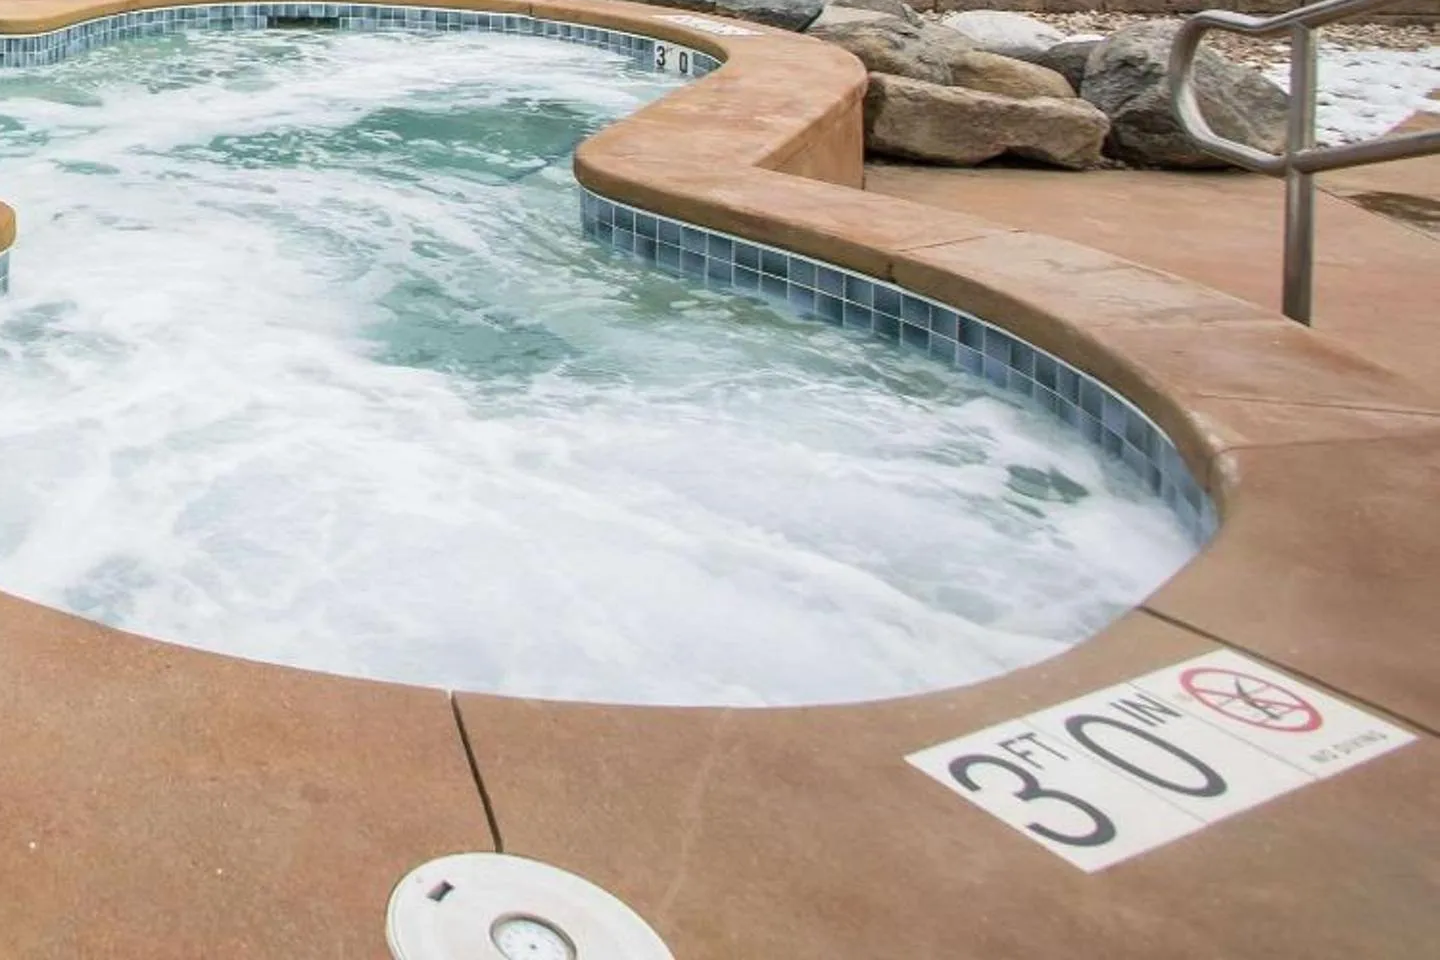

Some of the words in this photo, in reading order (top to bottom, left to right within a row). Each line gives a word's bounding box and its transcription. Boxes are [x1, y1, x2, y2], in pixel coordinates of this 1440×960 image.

[656, 45, 666, 67] 3
[679, 51, 689, 74] 0
[1109, 694, 1182, 727] IN
[998, 732, 1070, 770] FT
[1064, 713, 1228, 798] 0
[948, 754, 1117, 848] 3
